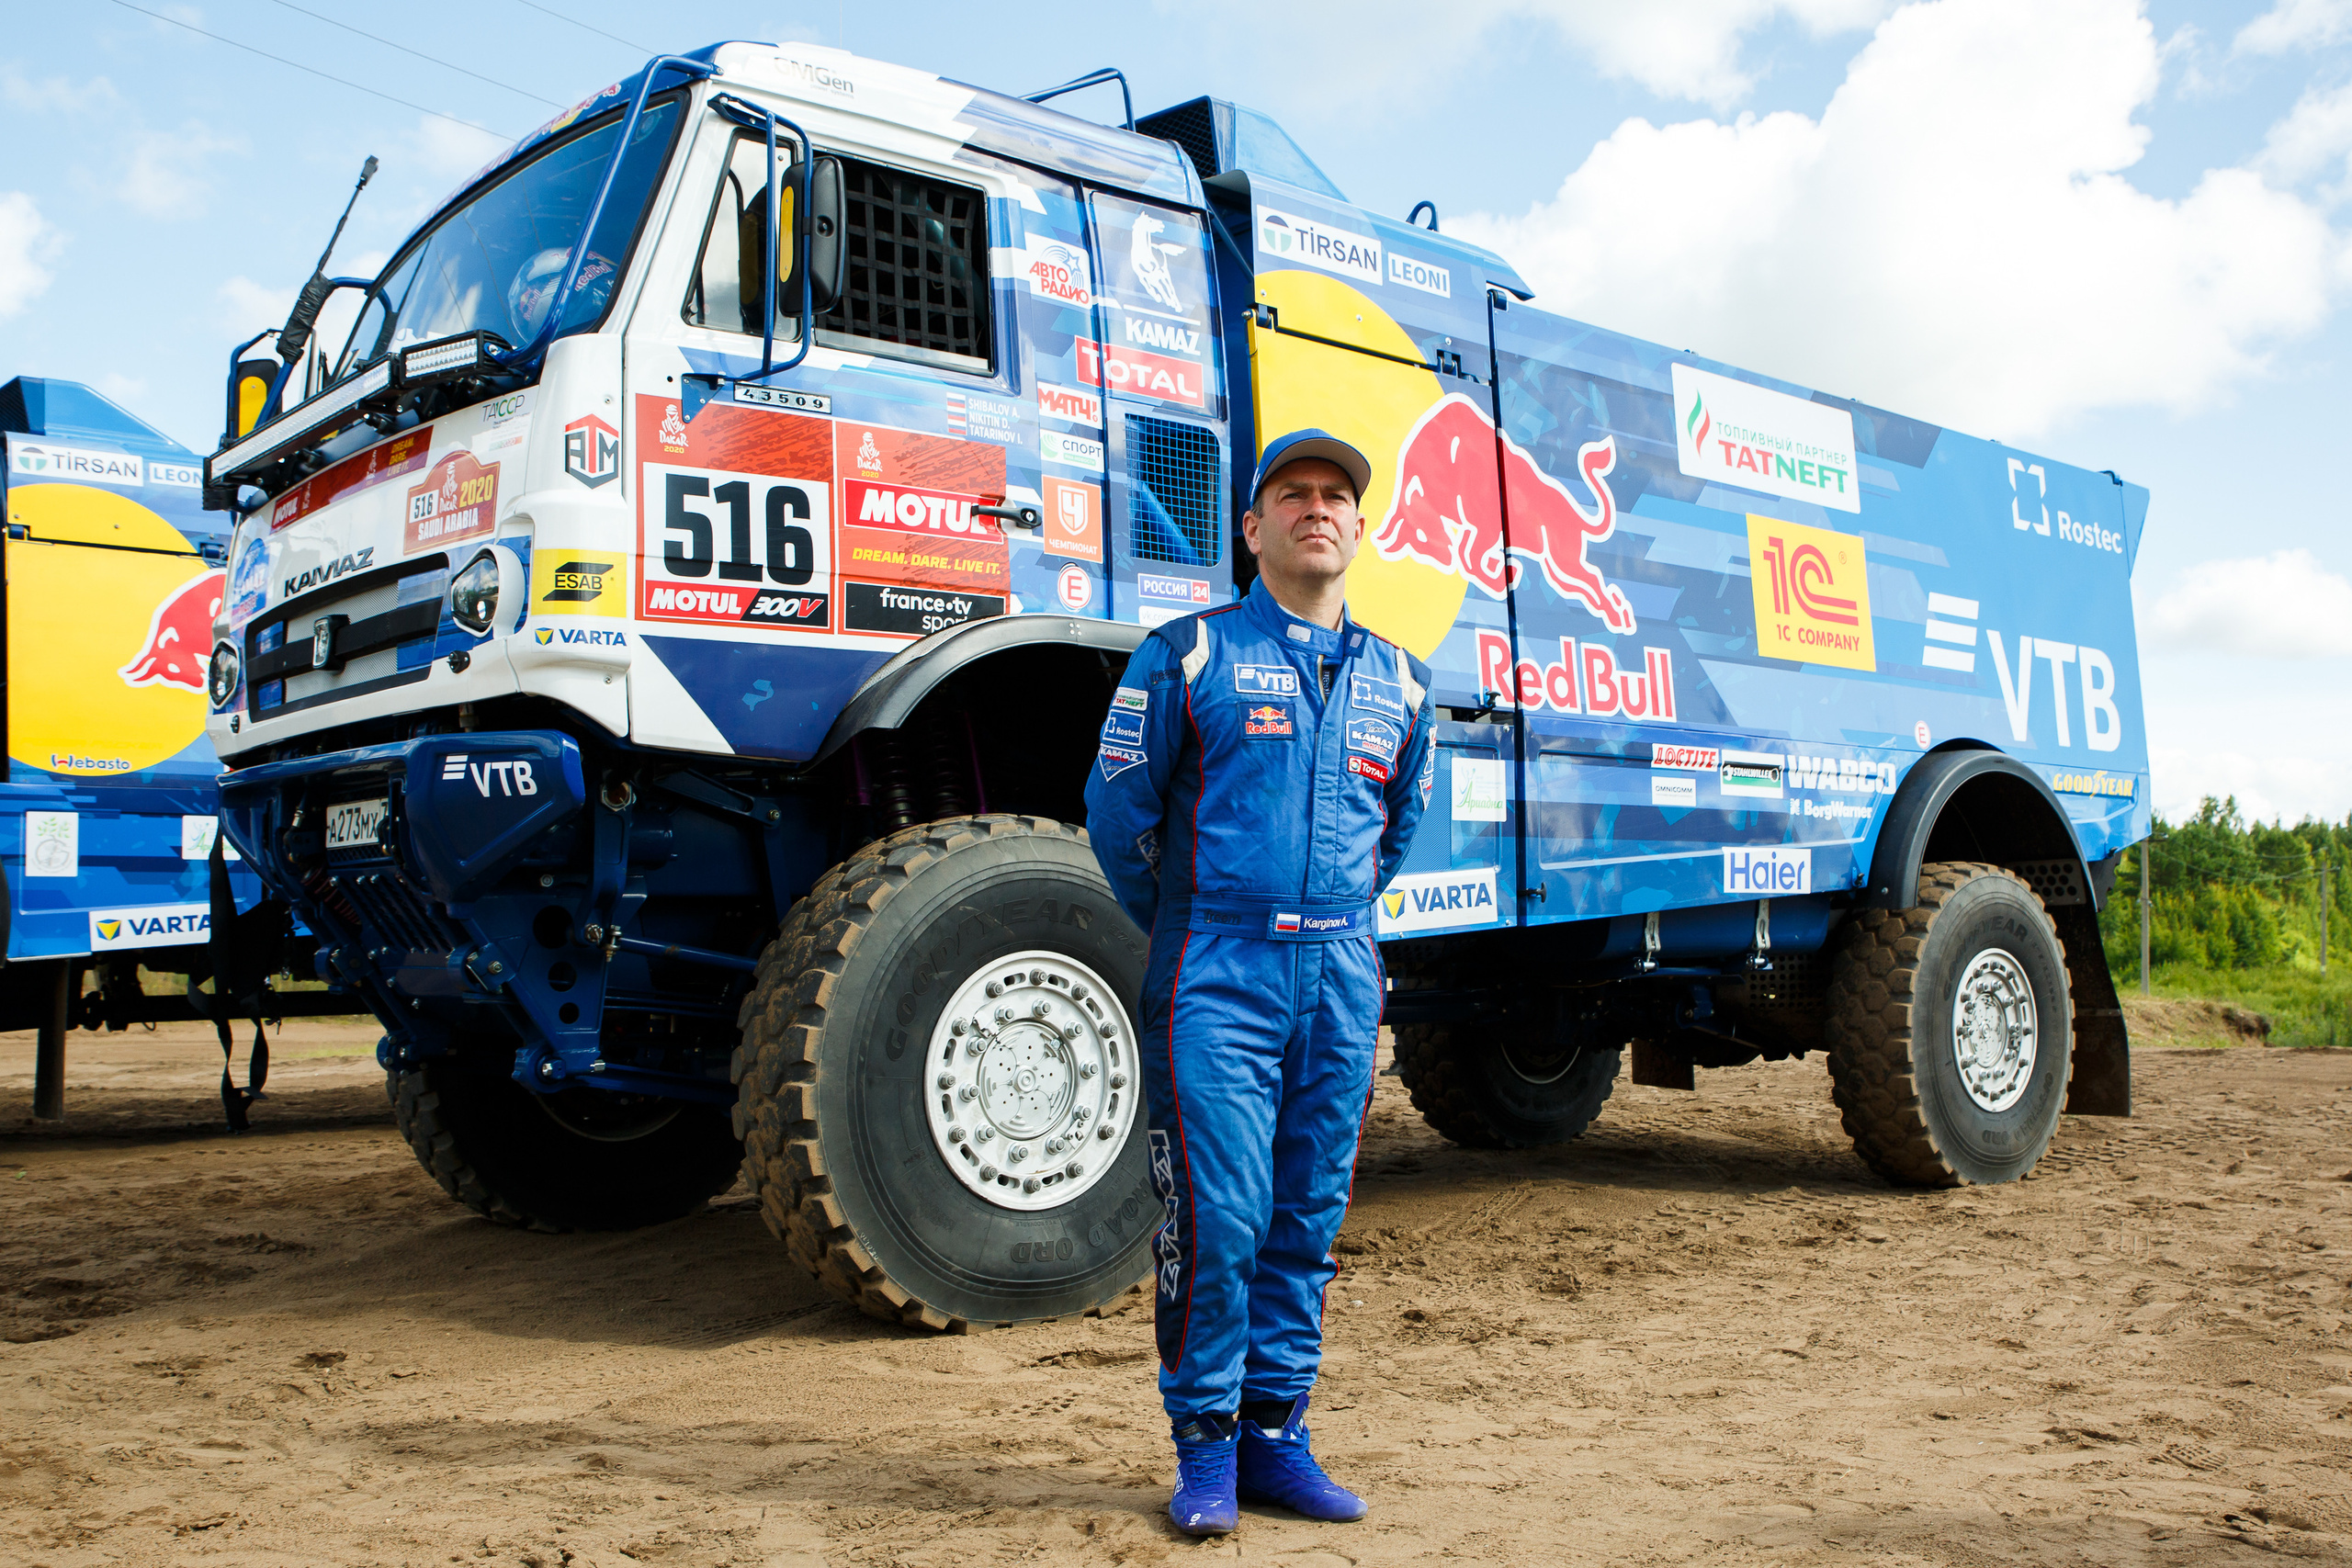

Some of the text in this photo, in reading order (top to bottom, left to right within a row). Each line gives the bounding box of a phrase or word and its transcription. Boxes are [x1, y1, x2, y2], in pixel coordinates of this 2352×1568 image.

[1029, 261, 1069, 283] АВТО
[1391, 258, 1448, 292] LEONI
[1041, 277, 1090, 304] РАДИО
[1125, 317, 1201, 355] KAMAZ
[1081, 345, 1198, 399] TOTAL
[743, 384, 823, 410] 43509
[968, 398, 1021, 419] SHIBALOV A.
[969, 412, 1011, 430] NIKITIN D.
[969, 424, 1023, 445] TATARINOV I.
[1716, 422, 1848, 465] ТОПЛИВНЫЙ ПАРТНЕР
[663, 446, 684, 454] 2020
[1062, 439, 1102, 458] СПОРТ
[153, 467, 203, 484] LEON
[861, 470, 879, 479] 2020
[1718, 439, 1849, 493] TATNEFT
[459, 474, 494, 508] 2020
[413, 493, 434, 520] 516
[860, 488, 988, 536] MOTUL
[418, 507, 479, 541] SAUDI ARABIA
[663, 472, 814, 586] 516
[2057, 510, 2123, 554] Rostec
[1049, 538, 1098, 555] ЧЕМПИОНАТ
[285, 546, 375, 598] KAMAZ
[853, 547, 1001, 575] DREAM. DARE. LIVE IT.
[555, 573, 603, 590] ESAB
[1068, 574, 1083, 601] E
[1143, 580, 1208, 599] РОССИЯ 24
[650, 587, 824, 618] MOTUL 300V
[559, 628, 628, 647] VARTA
[1798, 626, 1860, 651] COMPANY
[1255, 671, 1295, 692] VTB
[1476, 630, 1675, 721] Red Bull
[1985, 628, 2121, 752] VTB
[1374, 694, 1403, 712] Rostec
[1116, 727, 1140, 738] Rostec
[1245, 721, 1293, 735] Red Bull
[1918, 726, 1927, 744] E
[1351, 730, 1395, 750] KAMAZ
[51, 753, 130, 770] Webasto
[1101, 746, 1139, 762] KAMAZ
[1654, 746, 1717, 769] LOCTITE
[469, 761, 538, 798] VTB
[1362, 761, 1385, 780] TOTAL
[1787, 754, 1897, 795] WABCO
[1656, 784, 1693, 794] OMNICOMM
[1804, 799, 1873, 820] BorgWarner
[1730, 852, 1805, 890] Haier
[1411, 882, 1493, 913] VARTA
[129, 914, 211, 936] VARTA
[1304, 916, 1341, 931] Karginov
